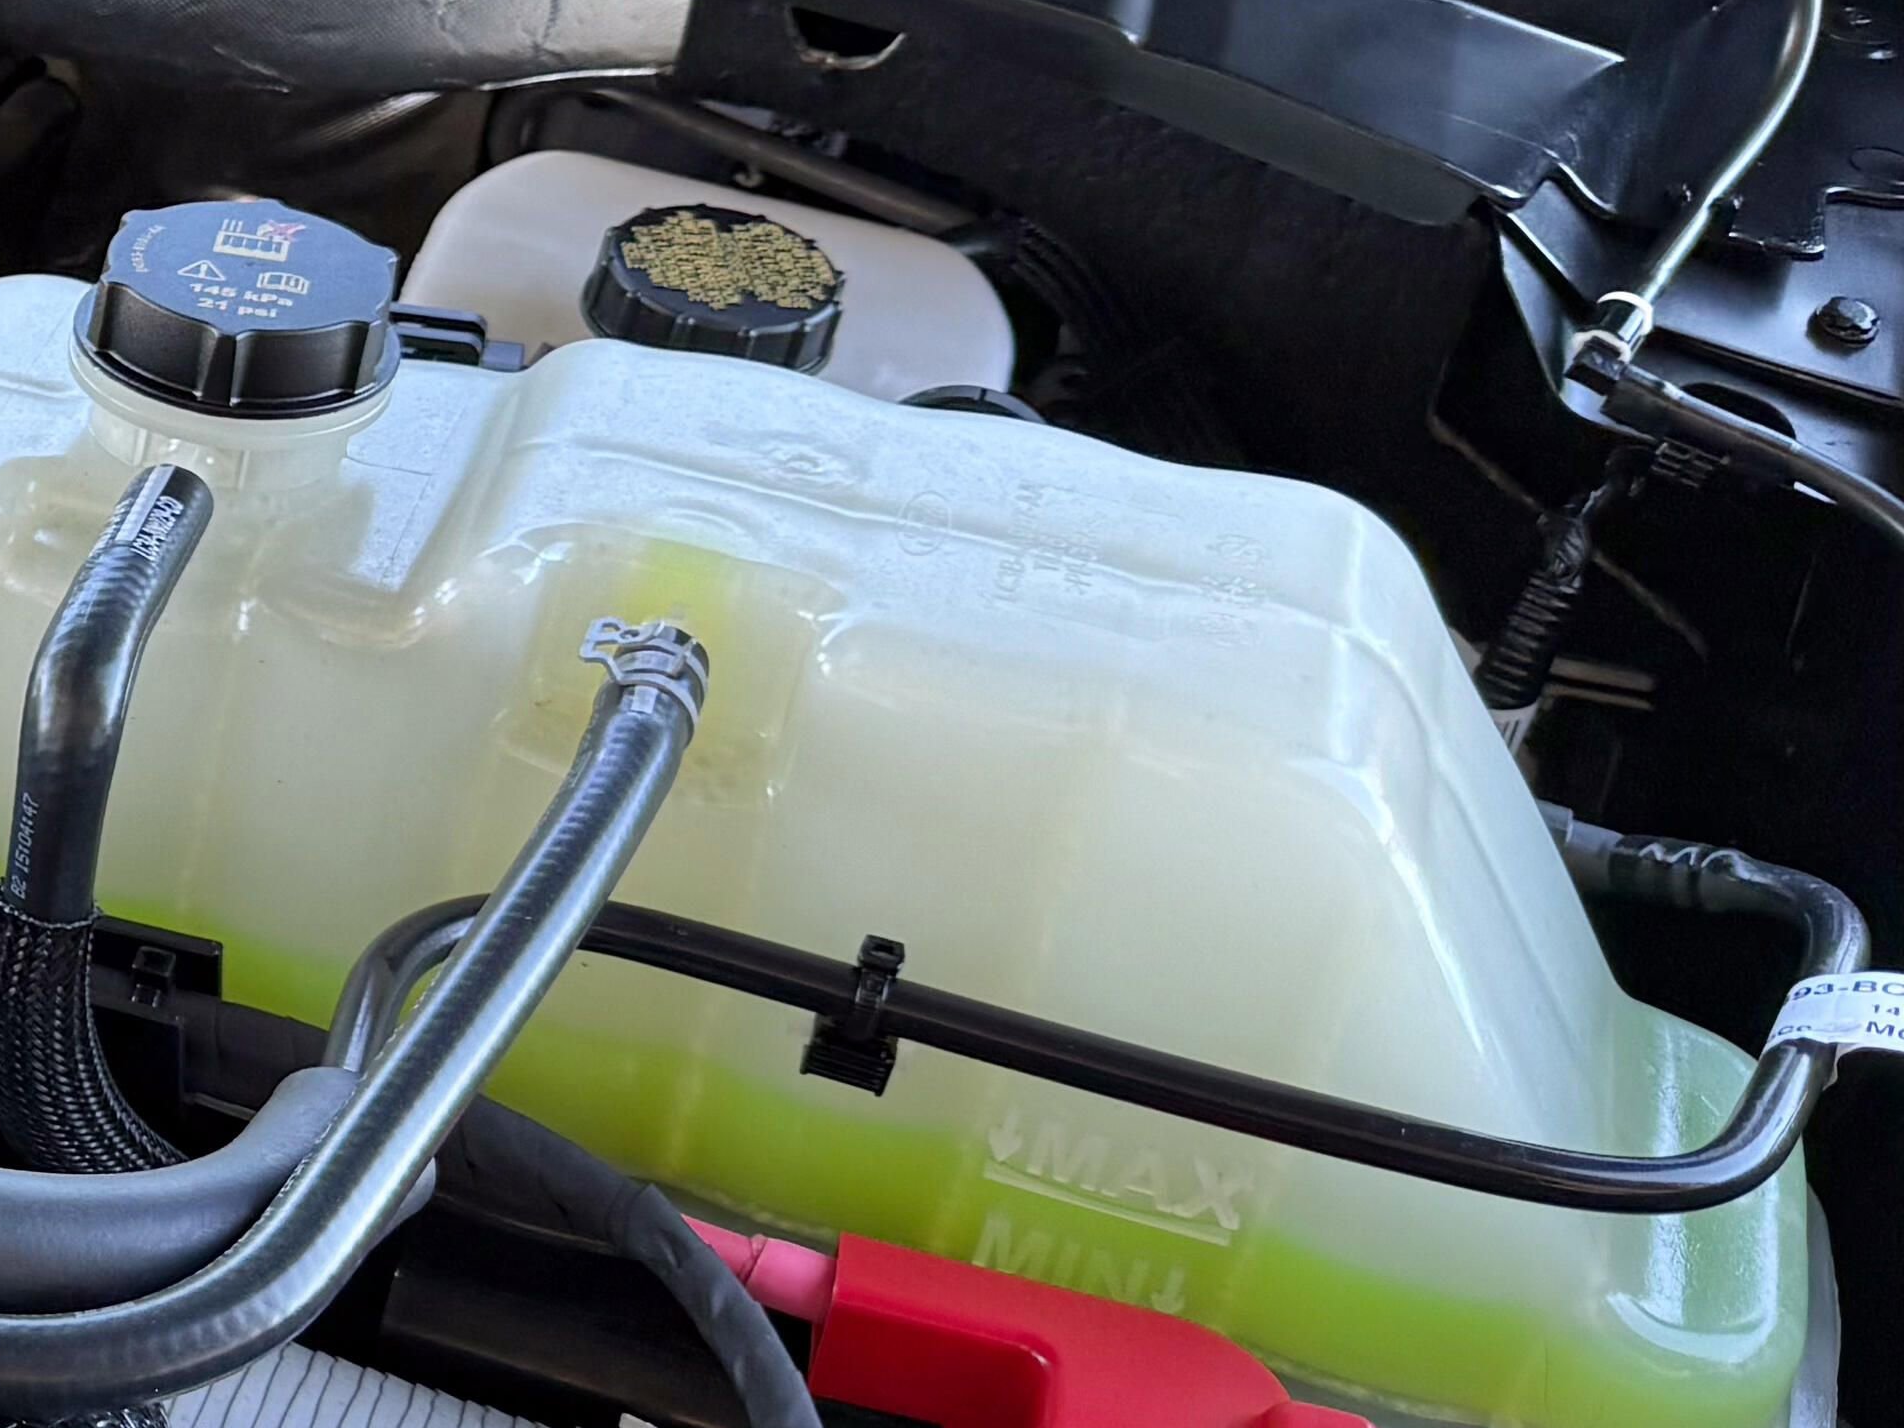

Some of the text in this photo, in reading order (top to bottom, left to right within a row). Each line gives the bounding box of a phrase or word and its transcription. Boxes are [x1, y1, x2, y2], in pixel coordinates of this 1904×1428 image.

[189, 283, 293, 307] 145 kPa
[197, 297, 277, 318] 21 psi
[1025, 1121, 1255, 1231] MAX
[971, 1204, 1150, 1302] MIN
